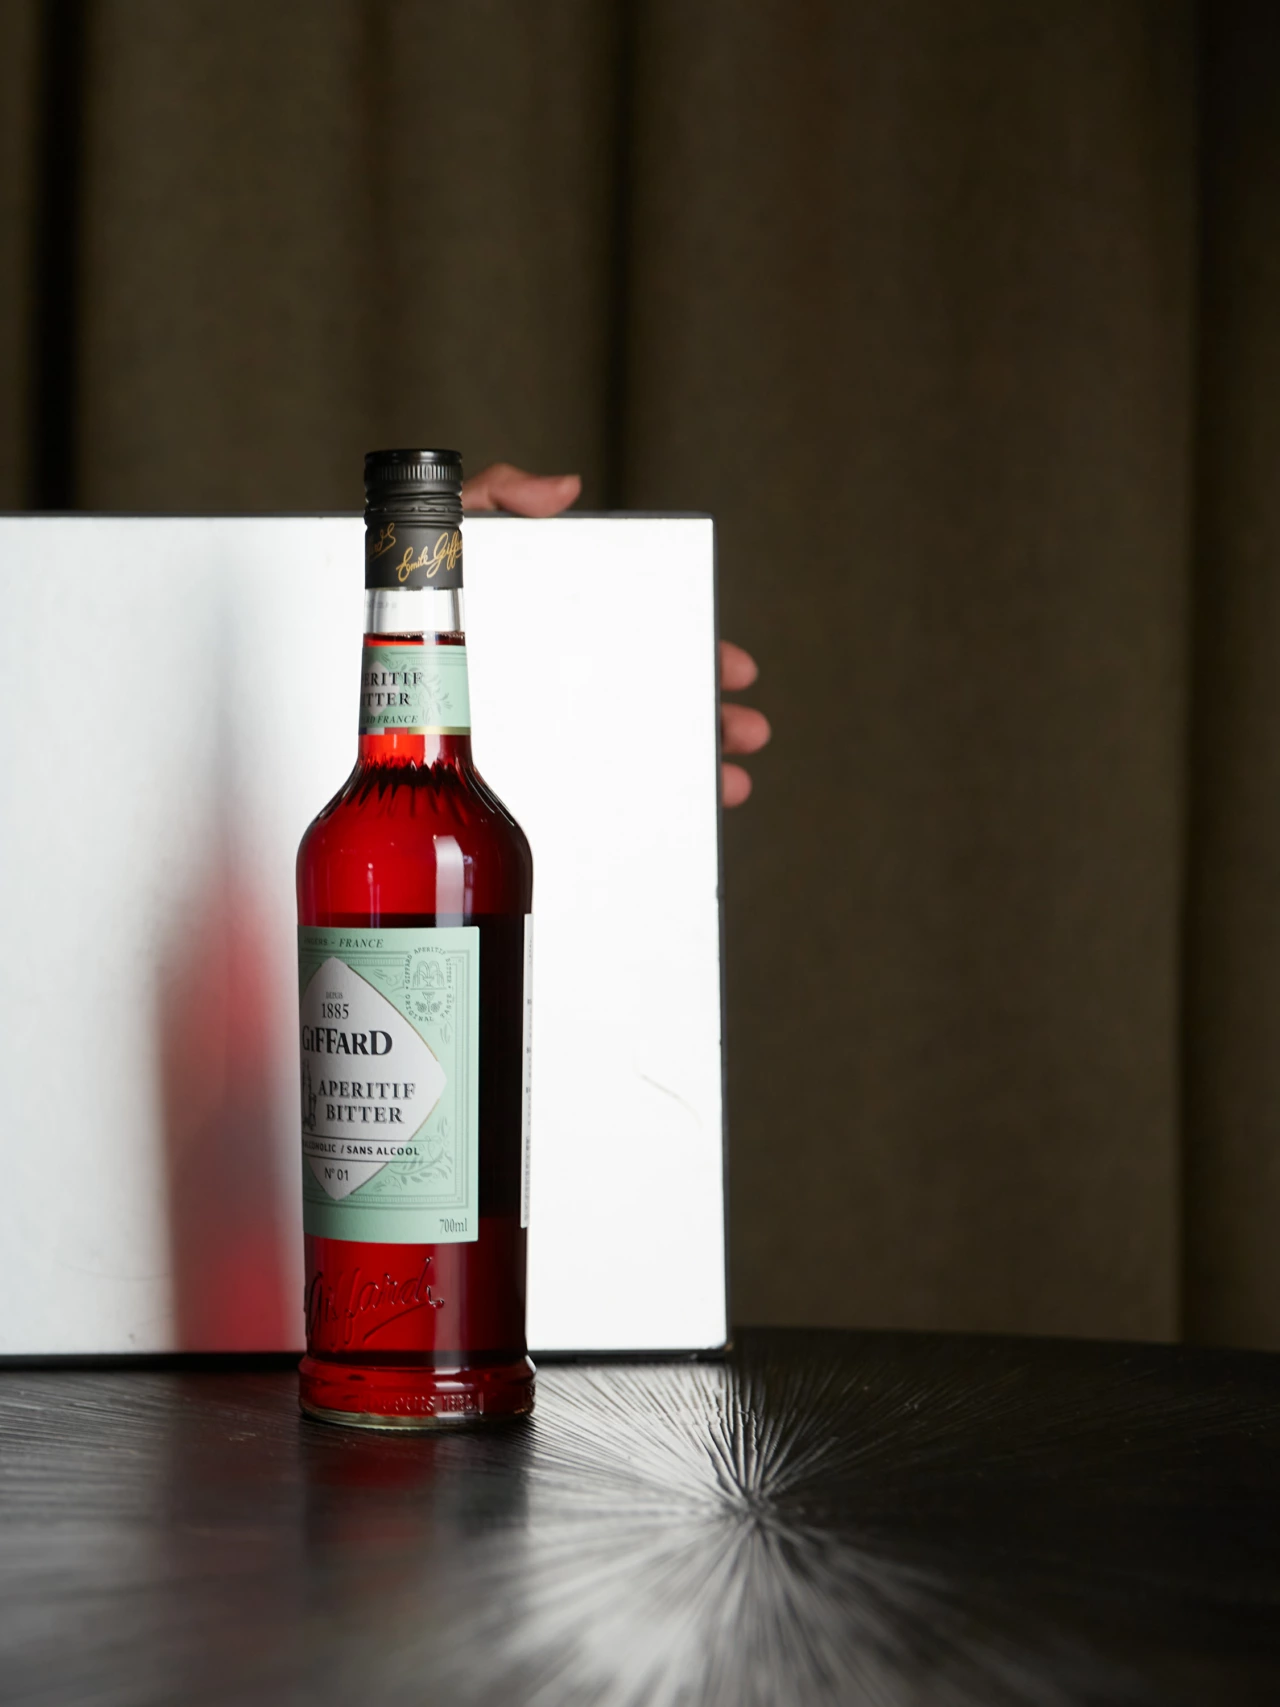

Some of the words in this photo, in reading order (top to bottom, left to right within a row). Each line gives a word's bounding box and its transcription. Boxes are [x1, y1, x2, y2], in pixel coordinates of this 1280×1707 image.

[377, 715, 419, 724] FRANCE
[339, 938, 384, 948] FRANCE
[321, 1003, 349, 1019] 1885
[319, 1080, 416, 1100] APERITIF
[326, 1104, 405, 1124] BITTER
[346, 1146, 373, 1155] SANS
[376, 1147, 420, 1156] ALCOOL
[337, 1169, 349, 1181] 01
[439, 1218, 468, 1234] 700ml
